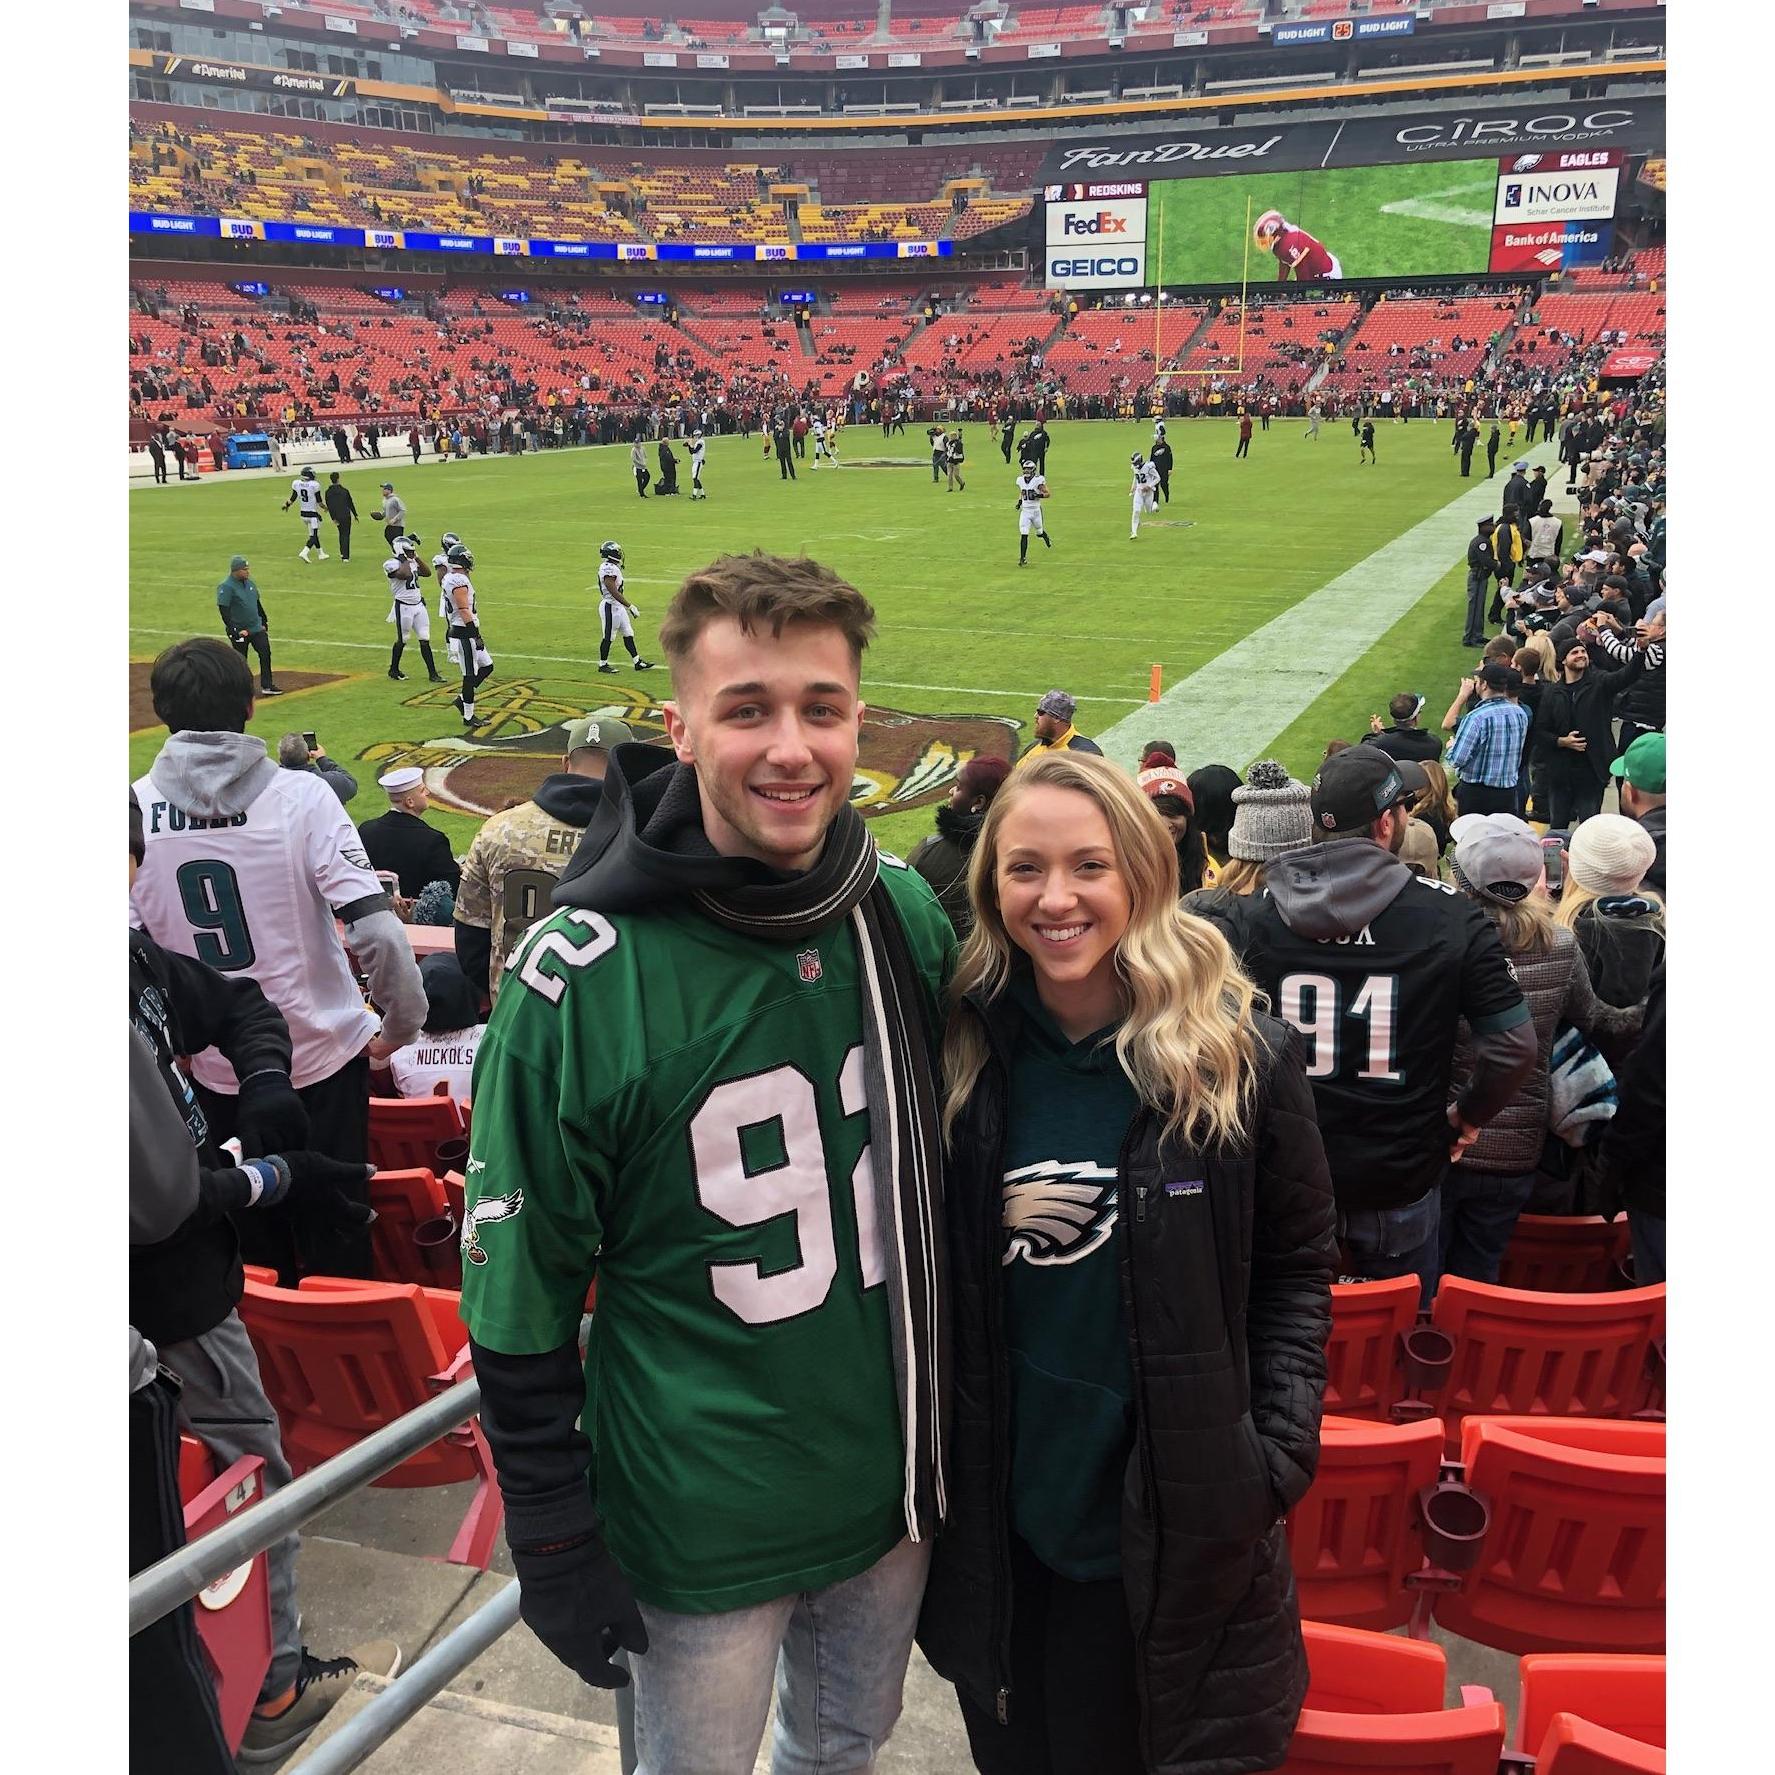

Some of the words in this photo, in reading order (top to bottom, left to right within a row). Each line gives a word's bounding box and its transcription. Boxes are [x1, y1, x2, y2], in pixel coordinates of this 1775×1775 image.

[1277, 31, 1297, 40] BUD
[1298, 28, 1326, 38] LIGHT
[1360, 23, 1380, 33] BUD
[1380, 20, 1410, 31] LIGHT
[1406, 140, 1458, 152] ULTRA
[1463, 134, 1547, 147] PREMIUM
[1553, 128, 1614, 141] VODKA
[1059, 135, 1282, 171] FanDuel
[1559, 152, 1609, 168] EAGLES
[1088, 182, 1143, 197] REDSKINS
[1527, 180, 1599, 204] INOVA
[1550, 206, 1577, 215] Cancer
[1579, 203, 1611, 213] Institute
[231, 223, 253, 235] BUD
[1064, 211, 1127, 235] FedEx
[375, 233, 394, 244] BUD
[1505, 233, 1535, 246] Bank
[1536, 232, 1550, 244] of
[1549, 231, 1598, 244] America
[502, 242, 520, 252] BUD
[626, 247, 646, 257] BUD
[765, 248, 786, 257] BUD
[908, 245, 927, 254] BUD
[1051, 257, 1138, 278] GEICO
[546, 828, 587, 854] ER
[176, 859, 257, 972] 9
[1280, 972, 1406, 1083] 91
[416, 1047, 473, 1065] NUCKOLS
[1169, 1186, 1203, 1198] patagonia
[236, 1481, 247, 1501] 4
